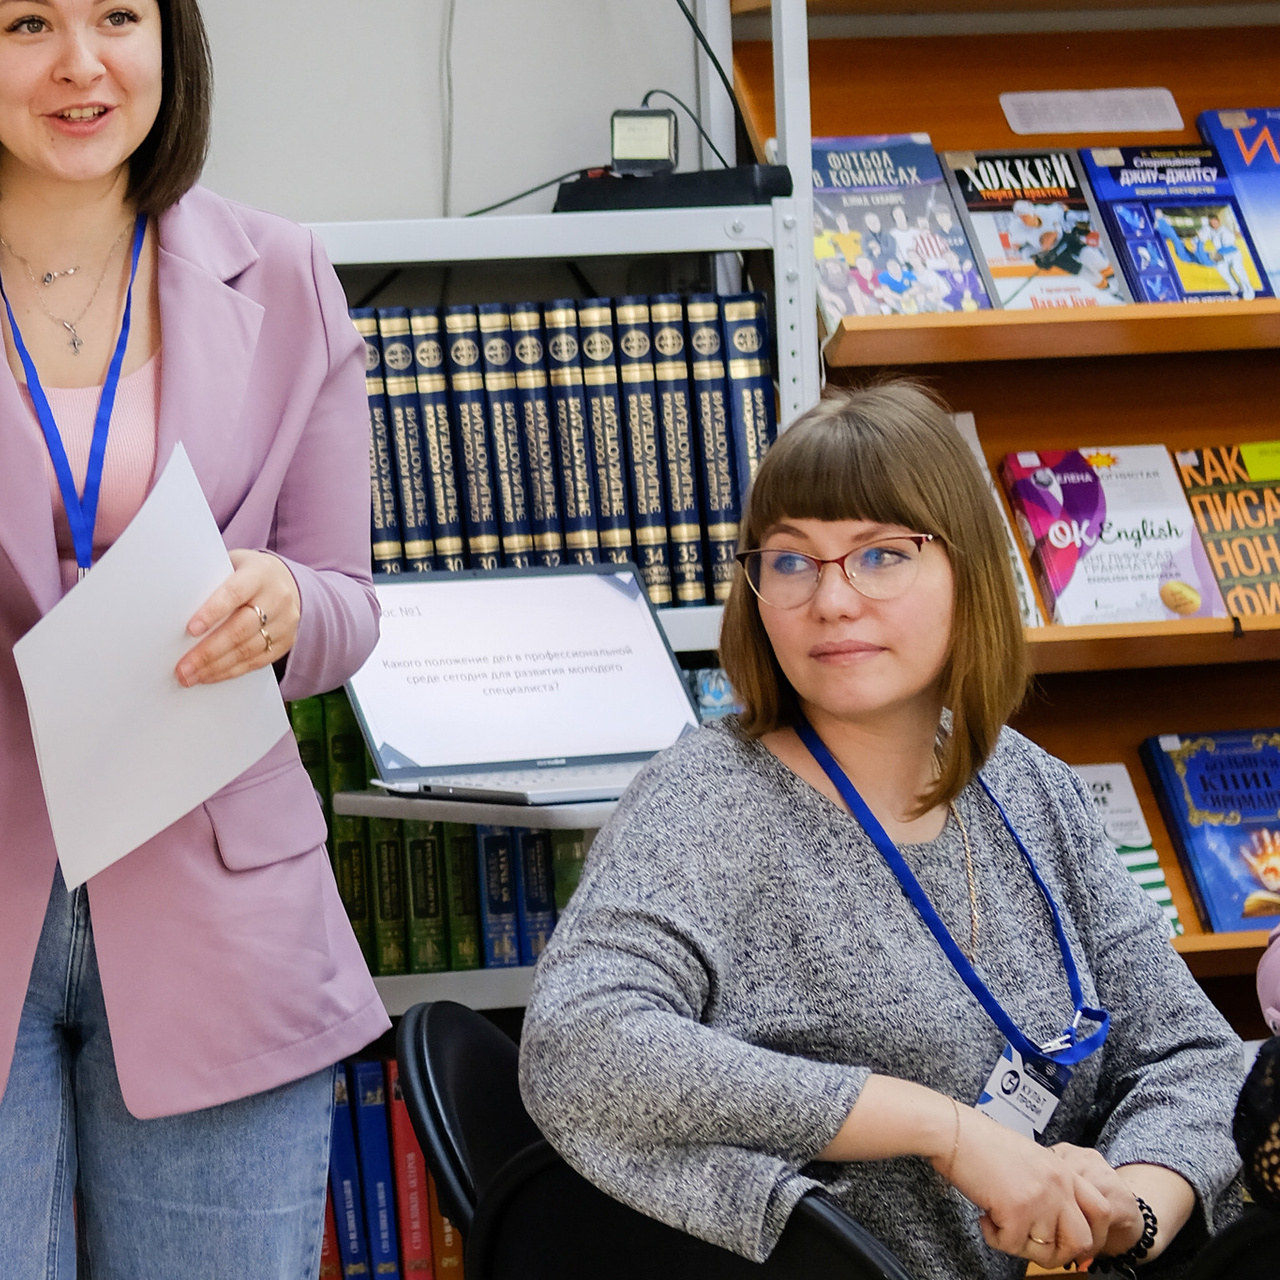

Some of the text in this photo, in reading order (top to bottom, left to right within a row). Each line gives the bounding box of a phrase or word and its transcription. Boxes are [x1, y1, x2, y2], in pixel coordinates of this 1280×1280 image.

[827, 150, 894, 170] ФУТБОЛ
[1133, 157, 1201, 169] Спортивное
[829, 166, 921, 188] КОМИКСАХ
[1120, 167, 1218, 186] ДЖИУ-ДЖИТСУ
[1048, 517, 1184, 549] OK English
[644, 548, 664, 565] 34
[678, 544, 698, 563] 35
[400, 606, 422, 618] №1
[382, 659, 421, 669] Какого
[424, 655, 489, 668] положение
[492, 654, 512, 665] дел
[524, 646, 633, 662] профессиональной
[406, 663, 623, 685] среде сегодня для развития молодого
[482, 683, 559, 697] специалиста?
[1022, 1084, 1046, 1105] КУЛЬТ
